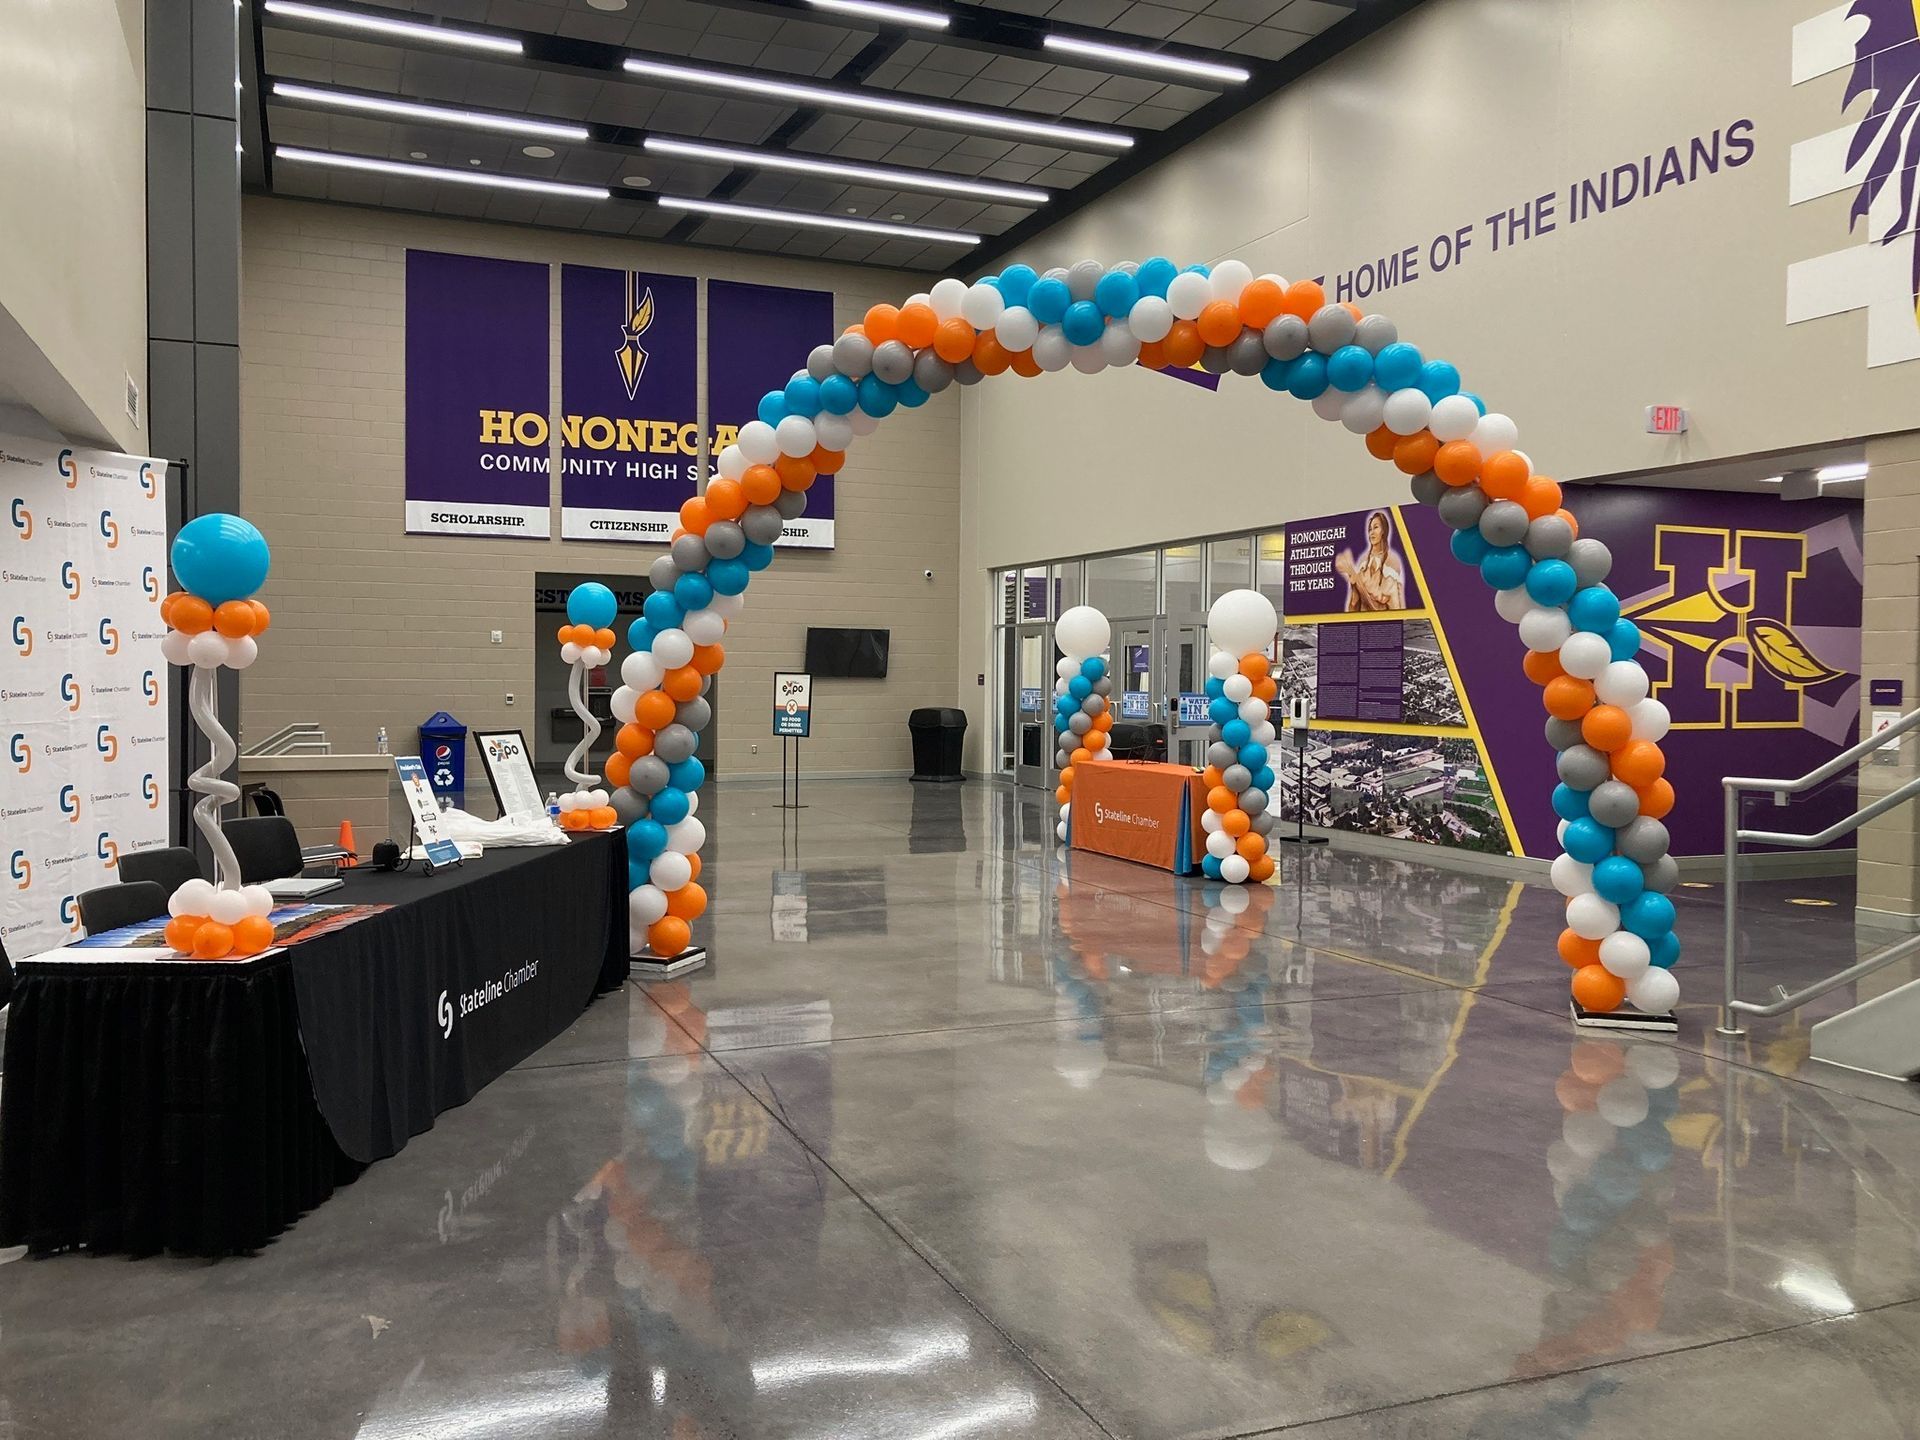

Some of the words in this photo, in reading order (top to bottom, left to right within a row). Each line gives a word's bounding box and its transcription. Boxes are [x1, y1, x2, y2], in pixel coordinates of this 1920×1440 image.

[1336, 245, 1419, 303] HOME
[1429, 224, 1473, 273] OF
[1485, 191, 1556, 252] THE
[1569, 118, 1755, 224] INDIANS
[1656, 407, 1679, 431] EXIT
[480, 453, 617, 476] COMMUNITY
[626, 461, 677, 480] HIGH
[430, 512, 526, 527] SCHOLARSHIP.
[589, 520, 670, 533] CITIZENSHIP.
[779, 527, 810, 538] SHIP.
[1290, 527, 1346, 544] HONONEGAH
[1290, 545, 1335, 560] ATHLETICS
[1289, 562, 1332, 575] THROUGH
[1289, 580, 1306, 591] THE
[1307, 578, 1335, 590] YEARS
[1188, 704, 1202, 714] IN
[1104, 808, 1131, 823] Stateline
[1132, 814, 1160, 828] Chamber
[459, 980, 503, 1018] Stateline
[503, 959, 539, 993] Chamber
